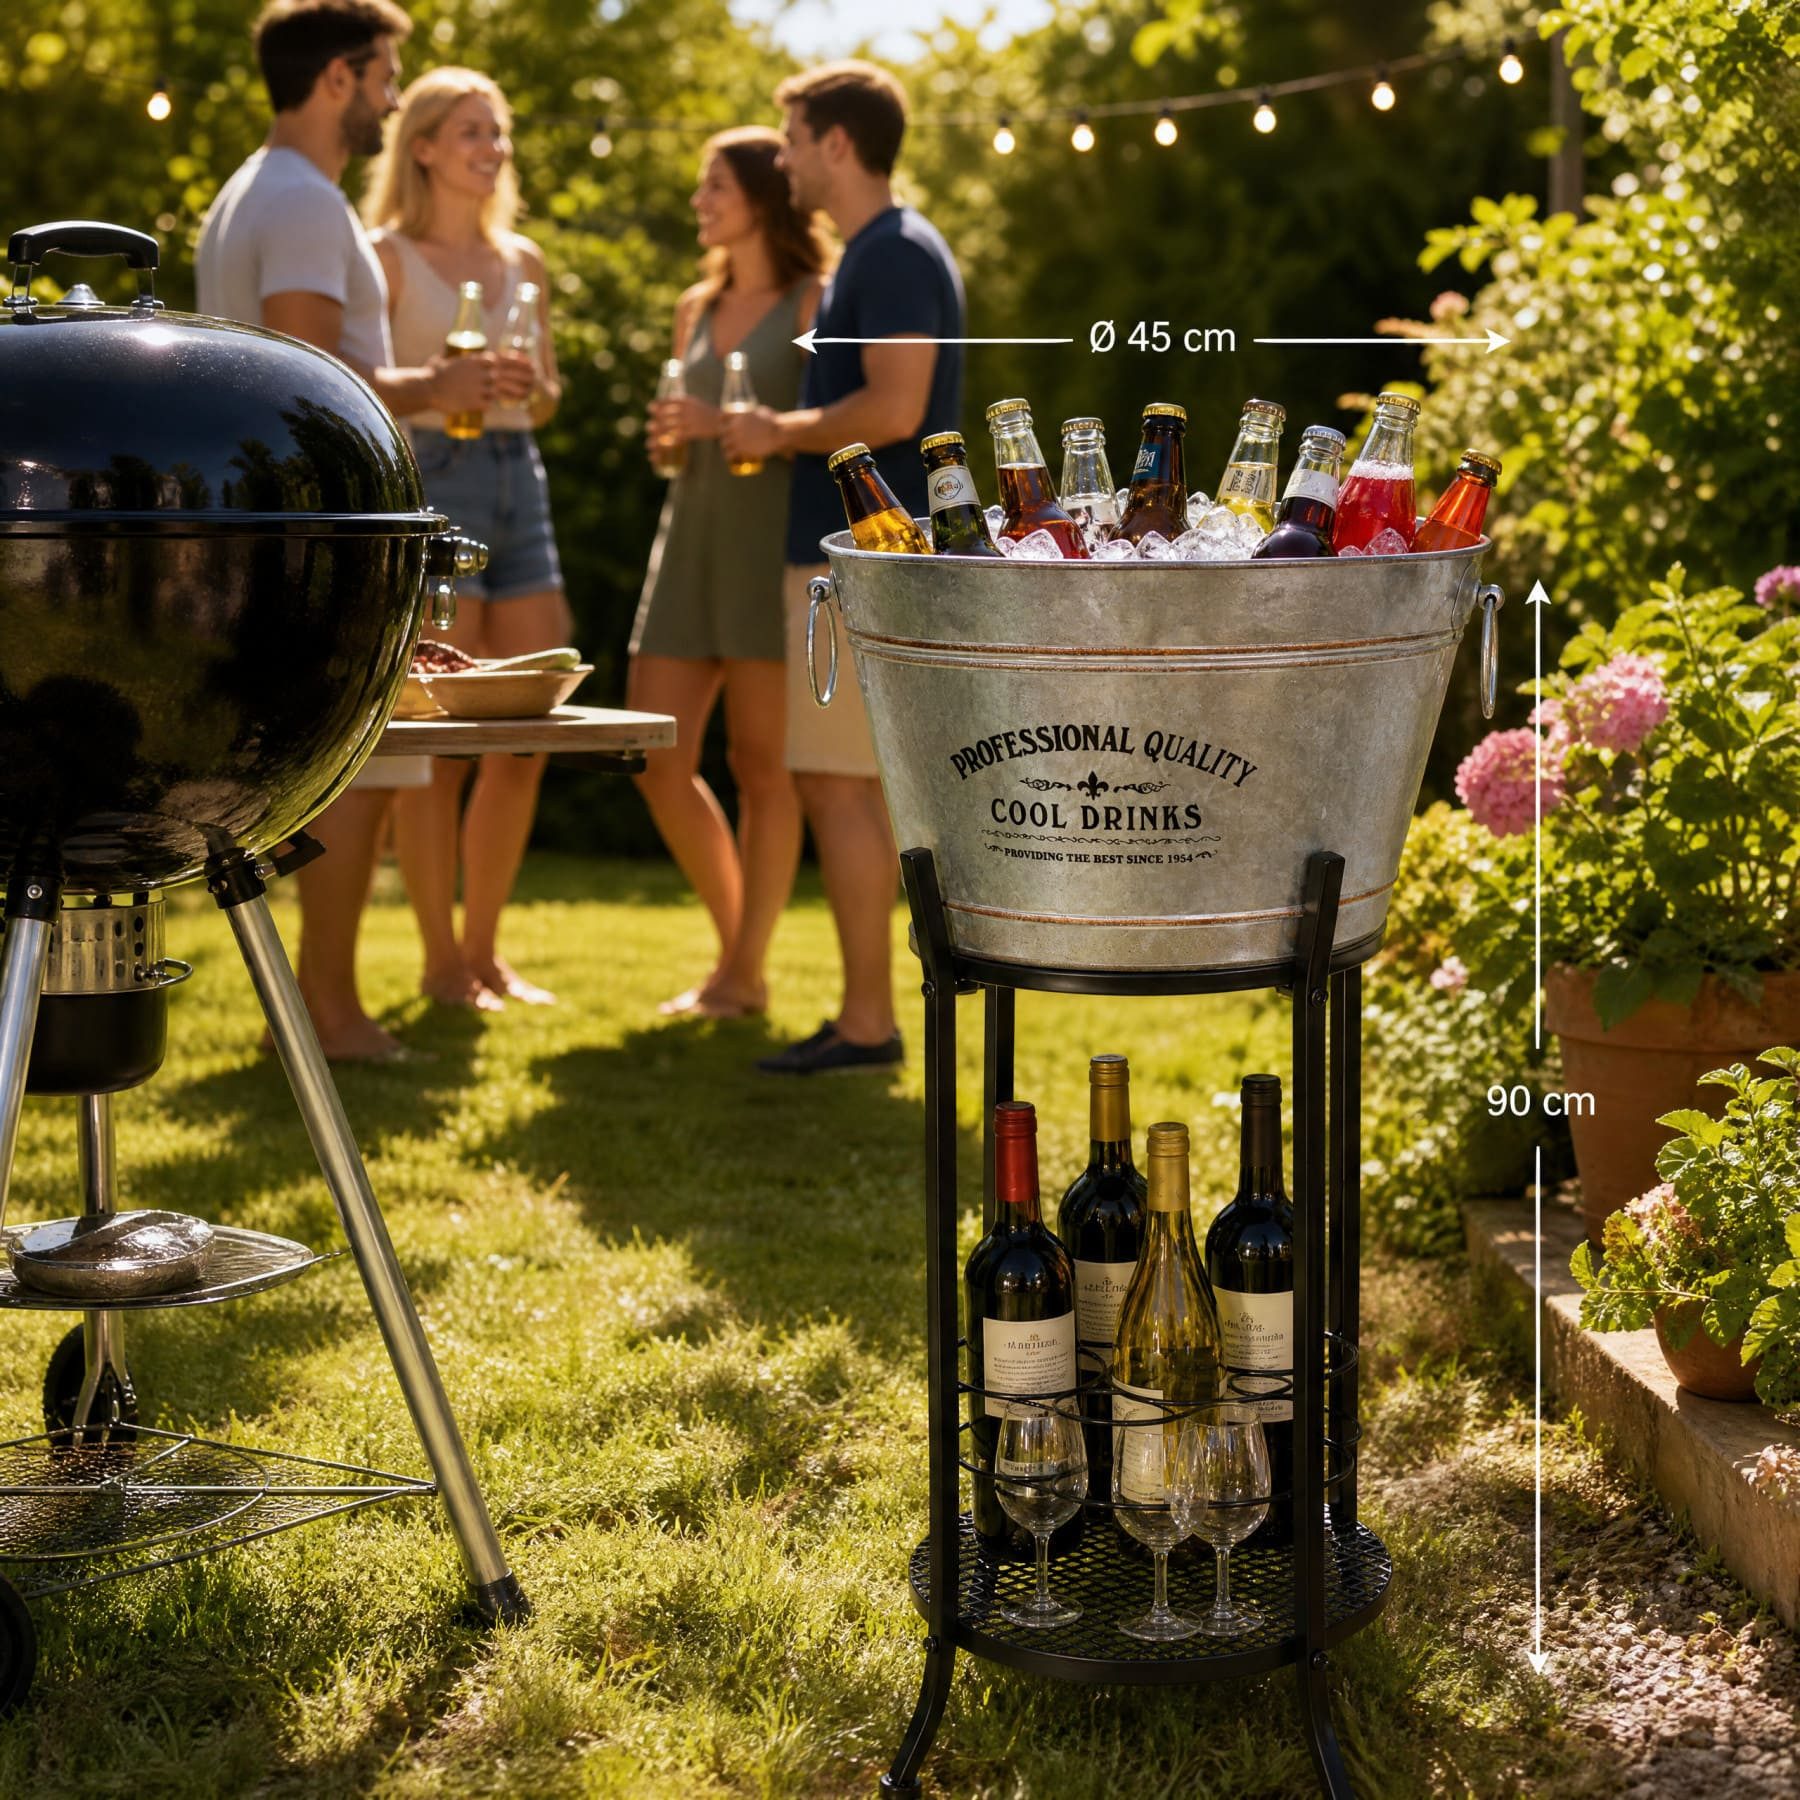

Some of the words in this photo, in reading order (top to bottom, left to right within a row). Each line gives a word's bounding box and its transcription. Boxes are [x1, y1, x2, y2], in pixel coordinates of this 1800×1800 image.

[950, 724, 1136, 781] PROFESSIONAL
[1144, 730, 1258, 788] QUALITY
[991, 798, 1067, 829] COOL
[1080, 803, 1202, 831] DRINKS
[1003, 847, 1064, 862] PROVIDING
[1066, 853, 1091, 863] THE
[1093, 854, 1124, 865] BEST
[1126, 854, 1164, 865] SINCE
[1167, 853, 1194, 864] 1954
